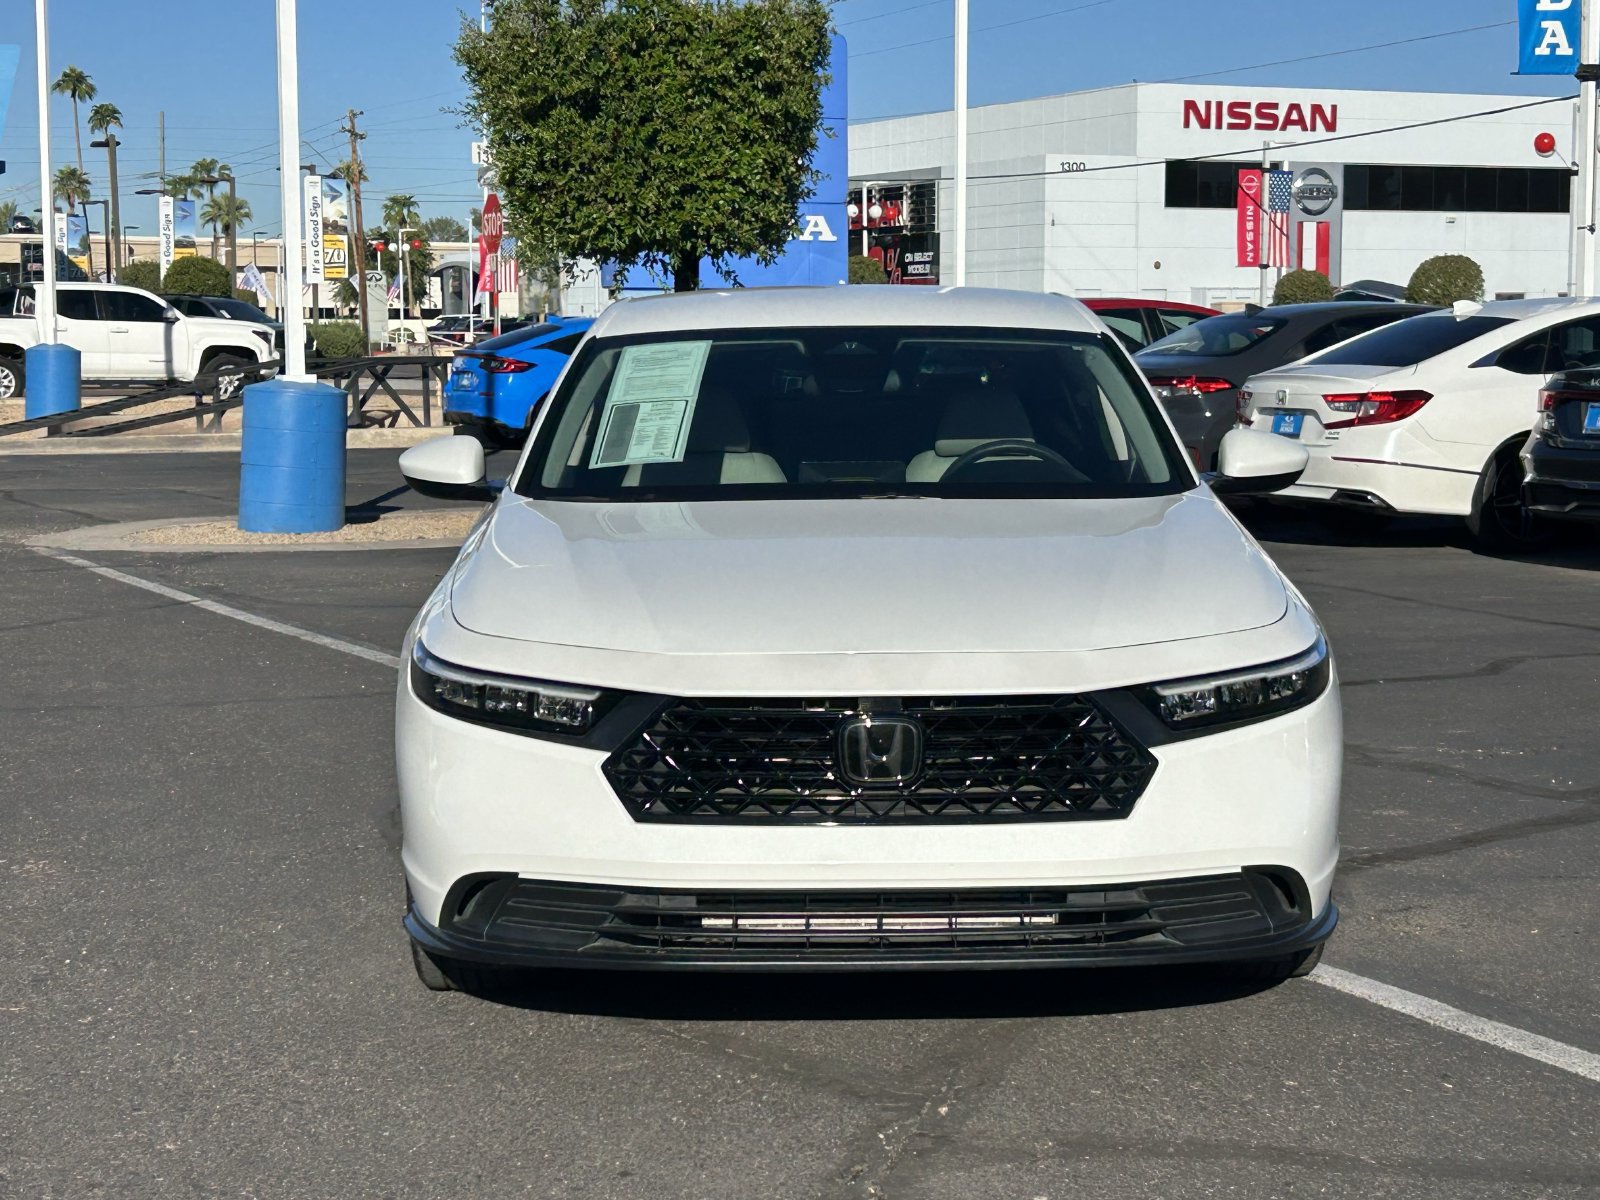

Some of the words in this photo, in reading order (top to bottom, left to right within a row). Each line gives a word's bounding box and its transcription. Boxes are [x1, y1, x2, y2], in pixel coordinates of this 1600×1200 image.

[1183, 100, 1337, 132] NISSAN
[1060, 161, 1086, 173] 1300
[310, 196, 320, 217] Sign
[162, 213, 172, 232] Sign
[484, 211, 502, 236] STOP
[57, 227, 66, 243] Sign
[163, 233, 171, 256] Good
[310, 220, 320, 248] Good
[1246, 206, 1254, 262] NISSAN
[312, 259, 320, 274] It's
